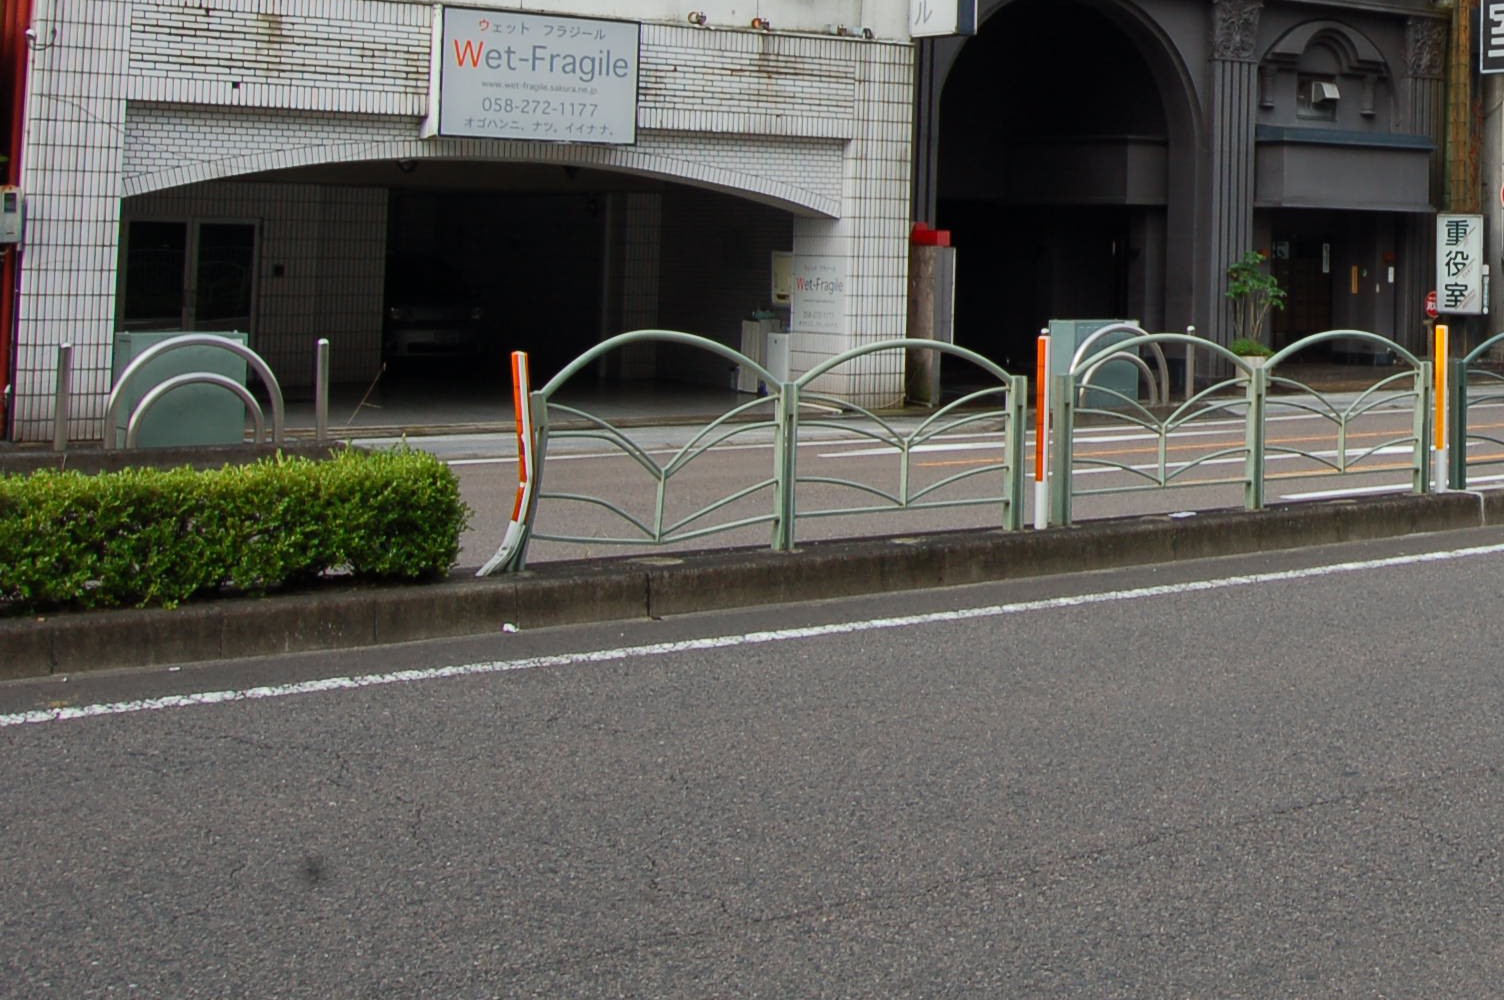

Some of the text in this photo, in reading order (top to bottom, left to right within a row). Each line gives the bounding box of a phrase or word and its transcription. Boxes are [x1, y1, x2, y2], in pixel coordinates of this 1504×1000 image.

[478, 18, 606, 41] ウェット フラジール
[454, 39, 629, 83] Wet-Fragile
[481, 97, 599, 118] 058-272-1177
[1444, 219, 1470, 309] 重役室
[796, 276, 845, 296] Wet-Fragile
